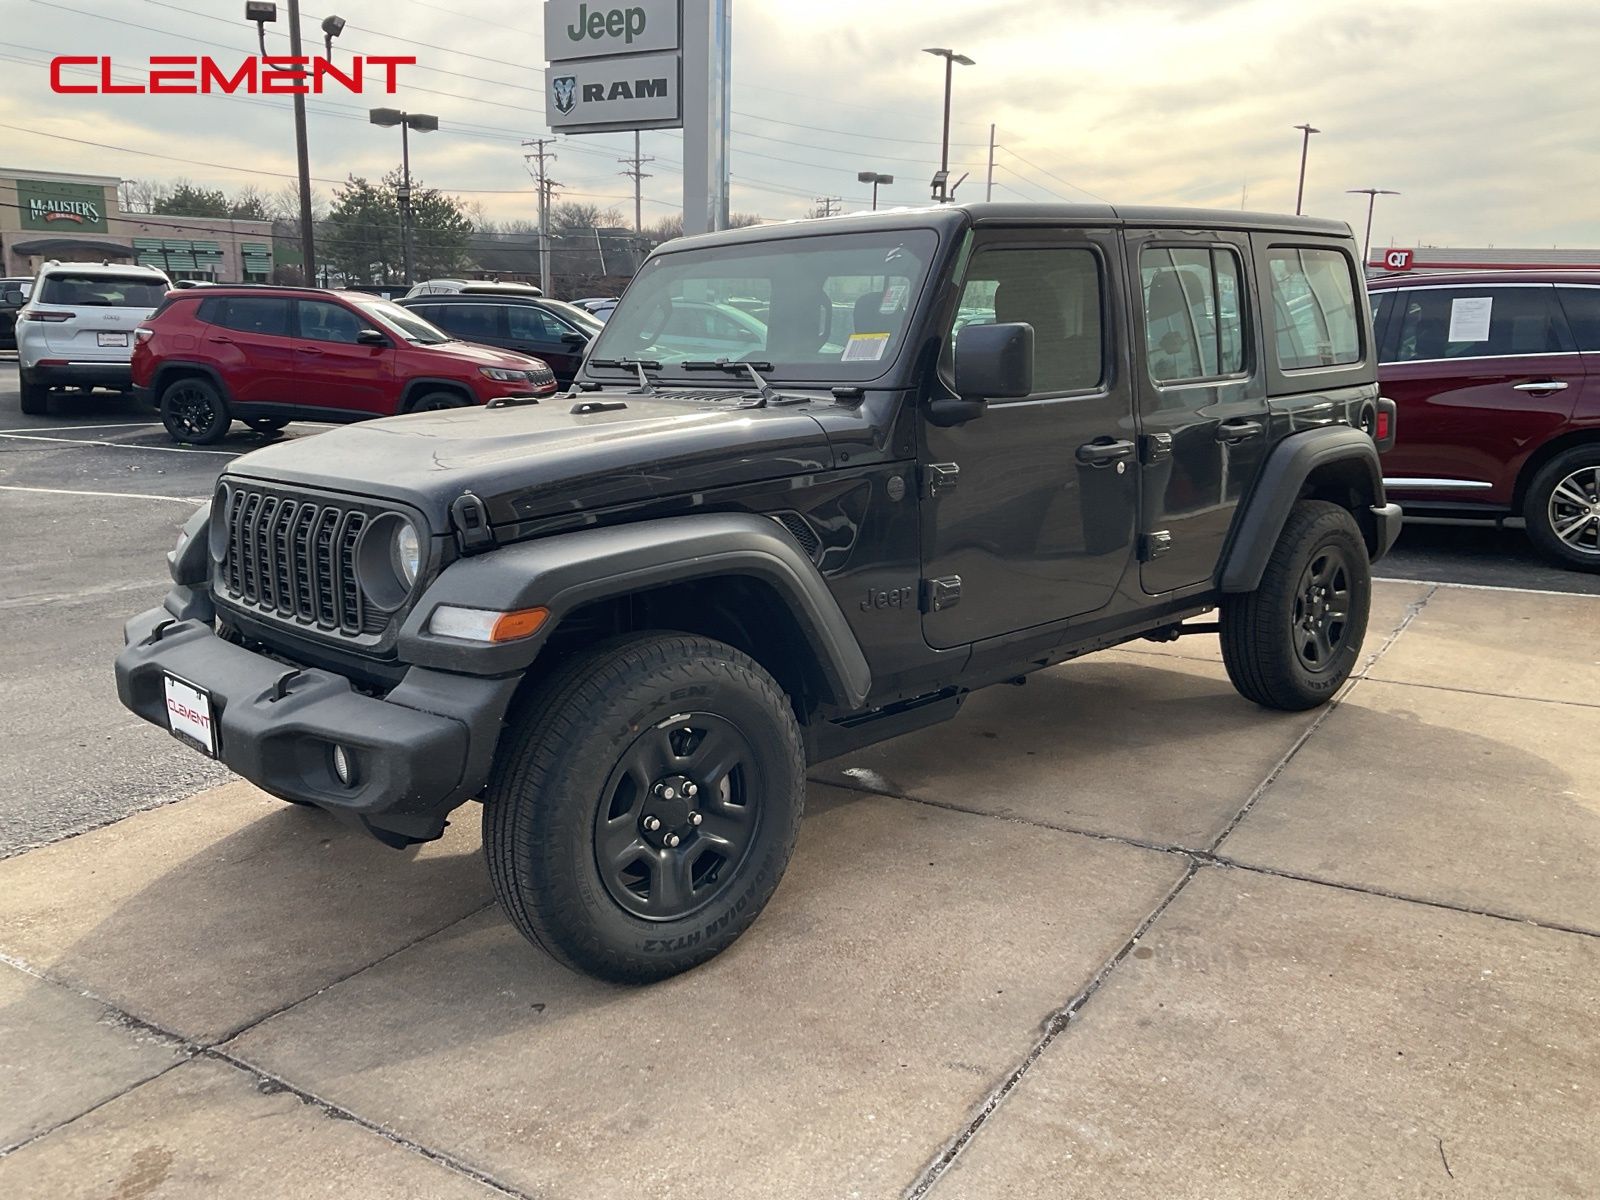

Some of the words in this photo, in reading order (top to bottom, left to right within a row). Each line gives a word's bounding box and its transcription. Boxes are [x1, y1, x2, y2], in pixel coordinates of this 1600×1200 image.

[568, 3, 646, 44] Jeep
[583, 78, 668, 103] RAM
[1388, 252, 1409, 267] QT
[859, 586, 912, 612] Jeep
[167, 698, 210, 729] CLEMENT
